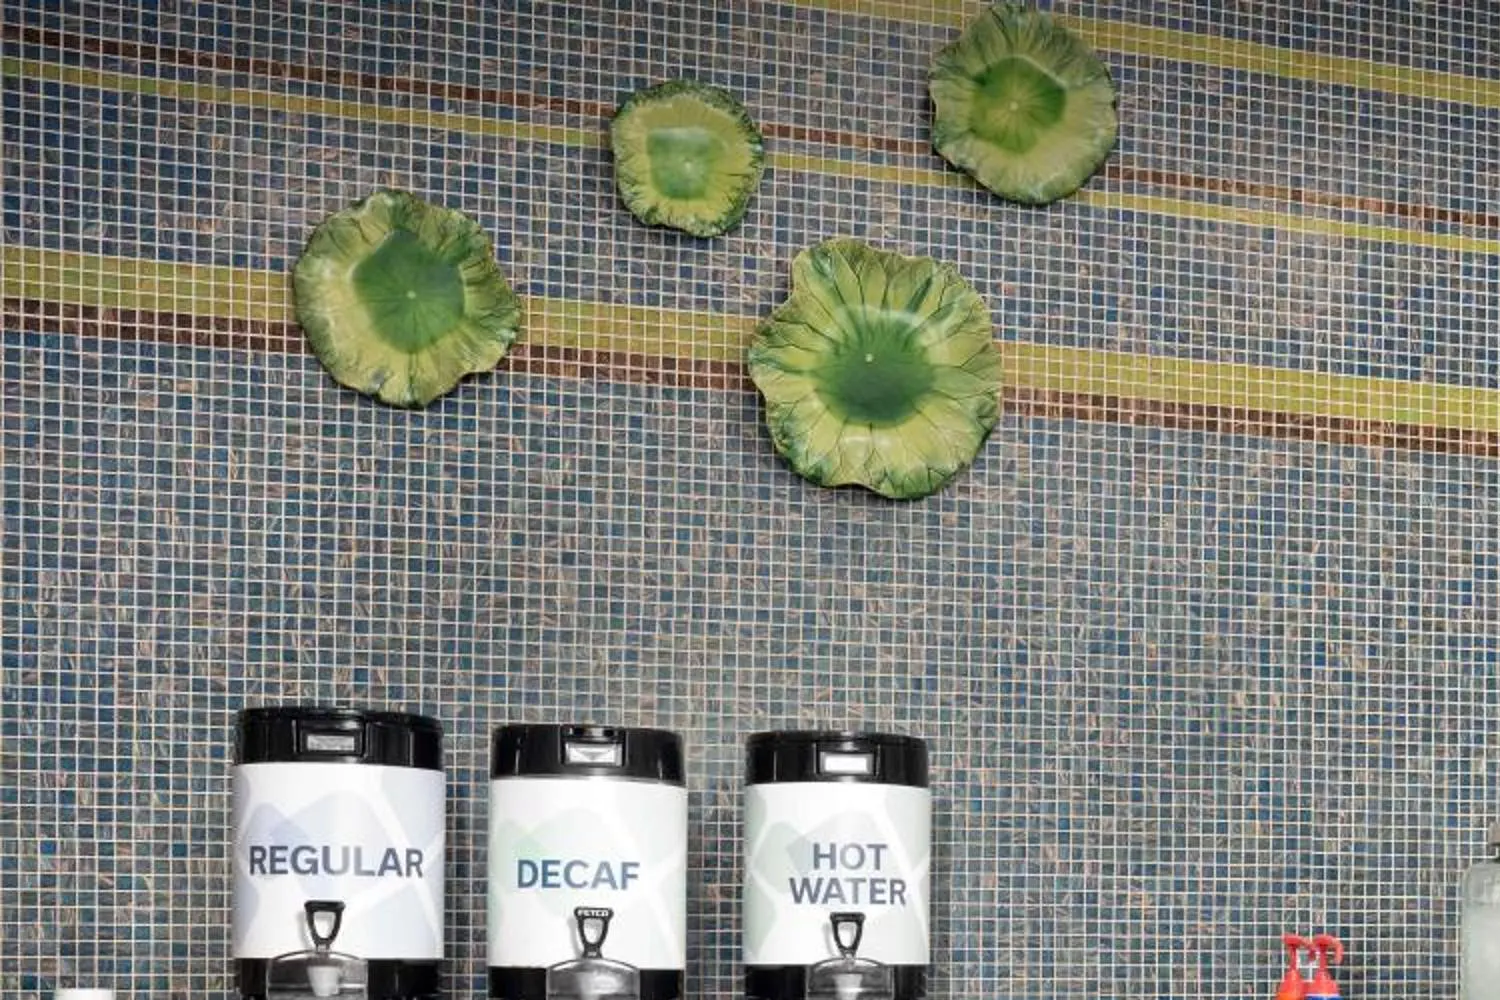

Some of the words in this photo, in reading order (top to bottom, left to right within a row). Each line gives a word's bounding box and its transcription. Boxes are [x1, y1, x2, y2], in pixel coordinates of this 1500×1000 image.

[249, 845, 424, 878] REGULAR
[813, 843, 888, 870] HOT
[517, 859, 640, 890] DECAF
[788, 877, 906, 905] WATER
